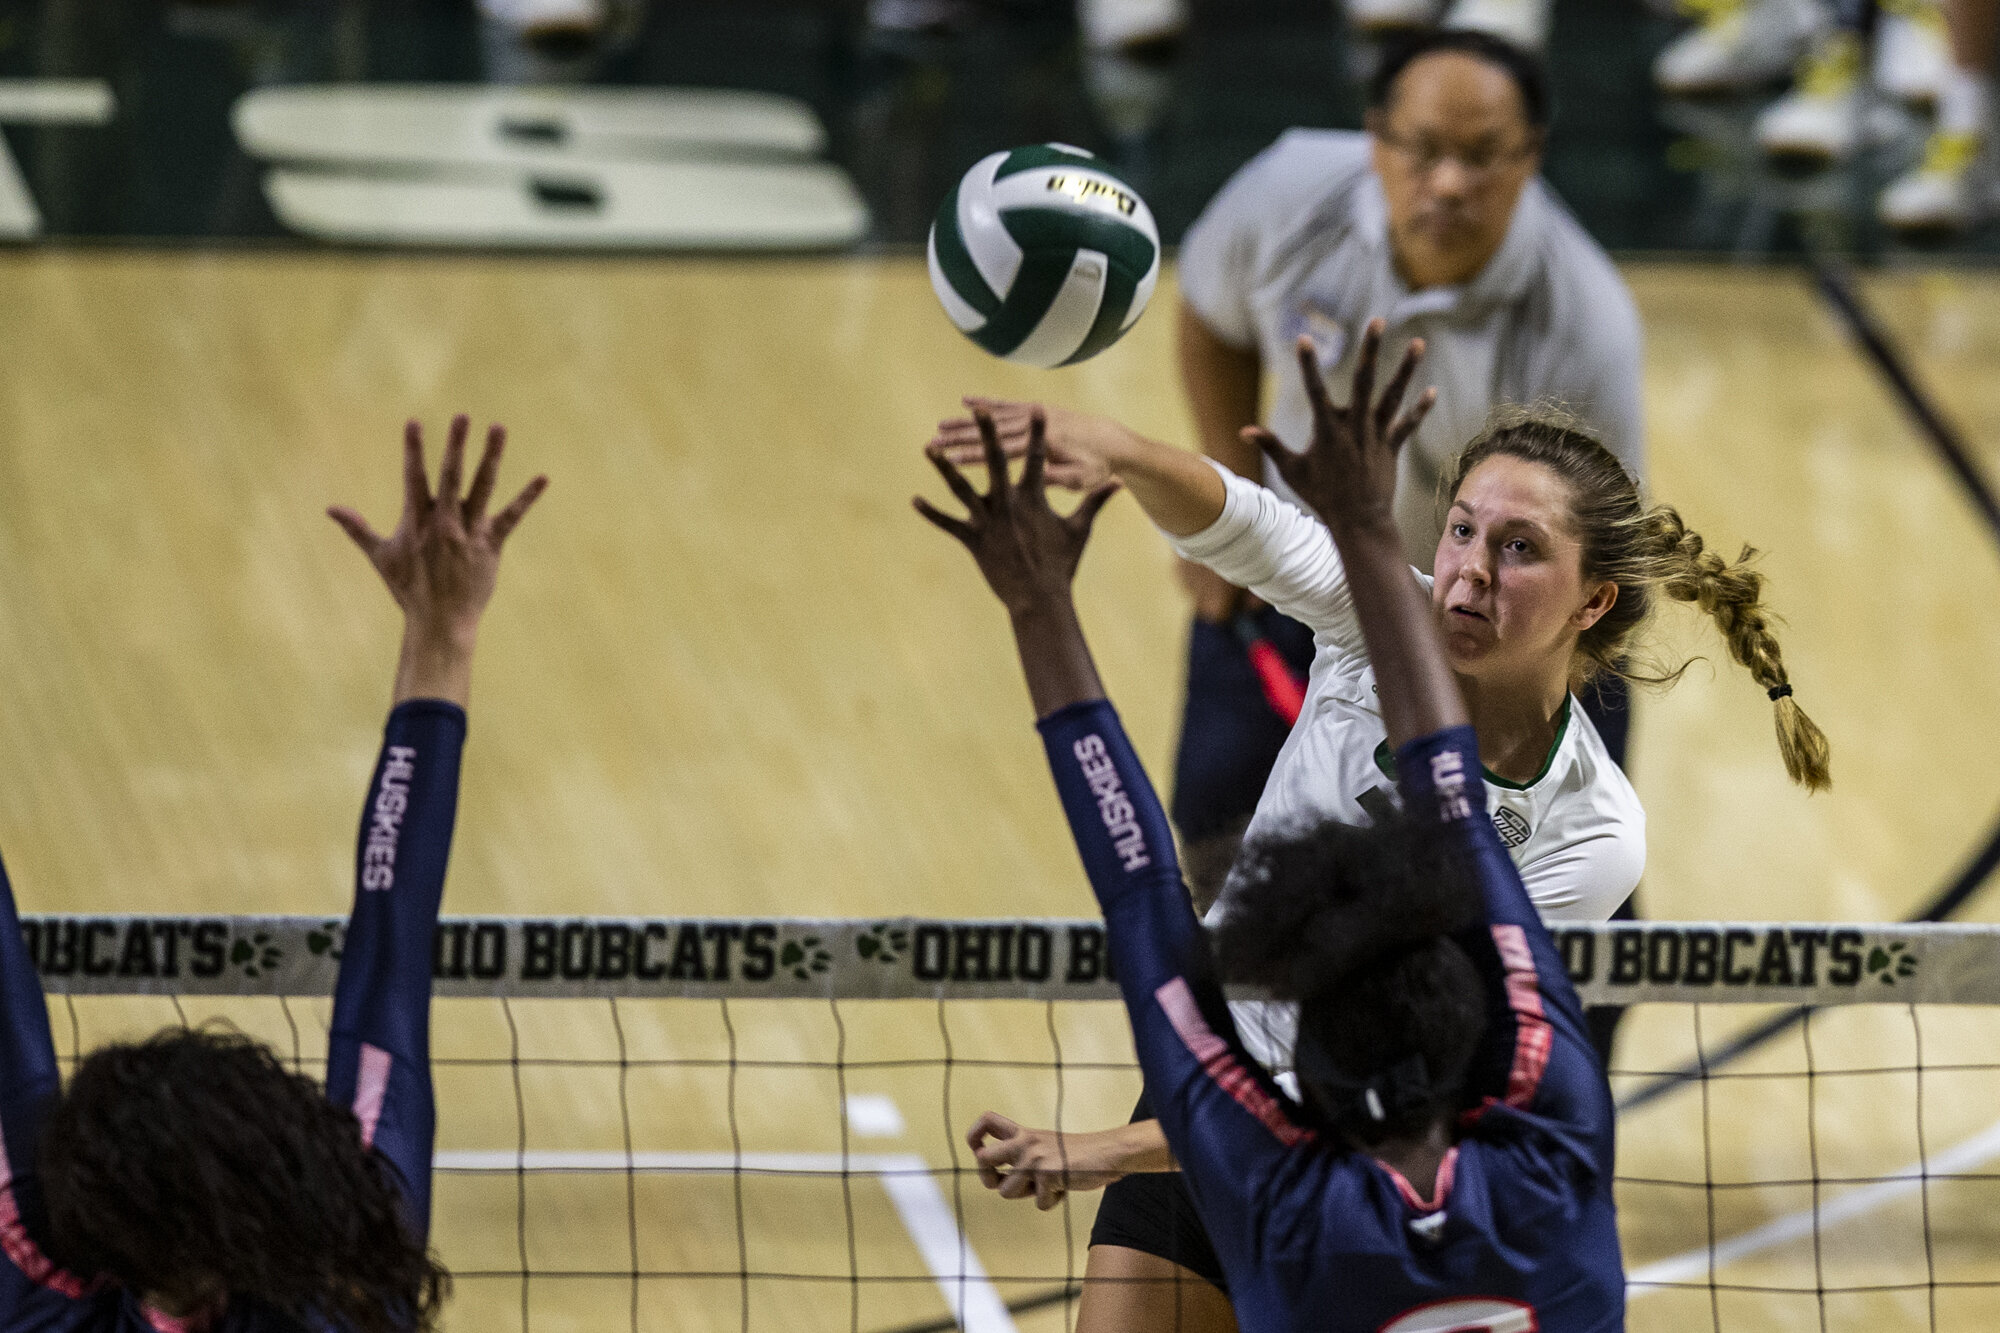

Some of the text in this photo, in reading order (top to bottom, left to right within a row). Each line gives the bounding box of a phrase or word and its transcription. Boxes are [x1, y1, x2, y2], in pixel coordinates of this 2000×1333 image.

[1046, 175, 1137, 217] Badn
[362, 745, 418, 891] HUSKIES
[1073, 733, 1152, 873] HUSKIES
[1492, 814, 1528, 846] MAC
[520, 922, 777, 981] BOBCATS
[913, 924, 1051, 982] OHIO
[1608, 928, 1863, 985] BOBCATS
